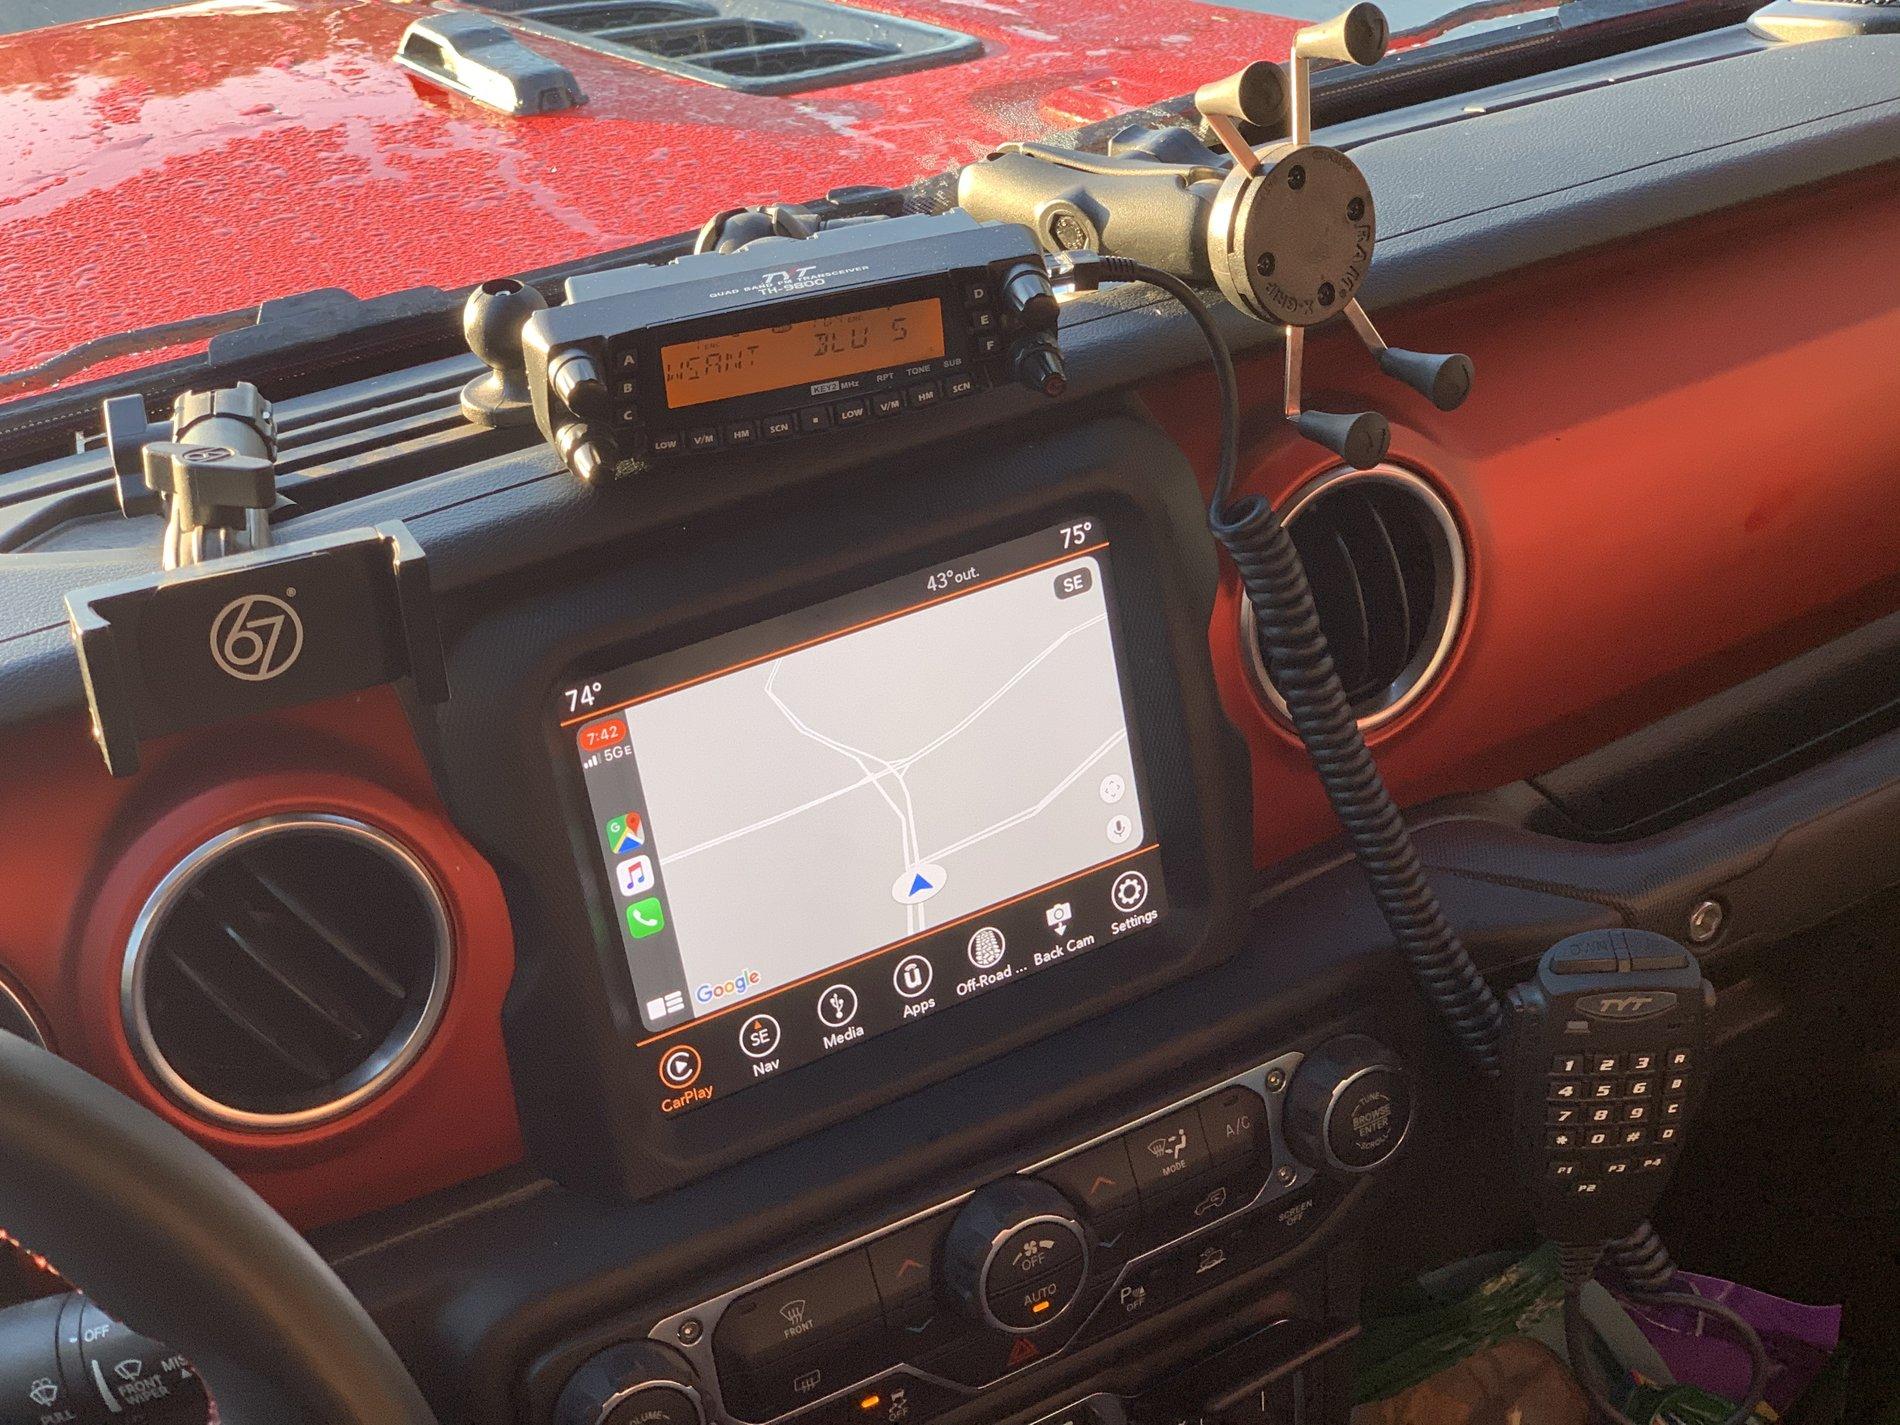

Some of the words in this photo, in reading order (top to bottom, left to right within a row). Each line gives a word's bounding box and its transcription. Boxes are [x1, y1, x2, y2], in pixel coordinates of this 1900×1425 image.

[709, 288, 739, 299] QUAD
[743, 282, 773, 292] BAND
[798, 265, 870, 282] TRANSCEIVER
[758, 278, 826, 297] TH-9800
[974, 289, 984, 299] D
[980, 314, 990, 325] E
[986, 340, 995, 350] F
[623, 355, 635, 366] A
[943, 358, 962, 369] SUB
[876, 372, 895, 383] RPT
[906, 364, 931, 377] TONE
[623, 383, 633, 394] B
[841, 380, 860, 391] MHz
[952, 381, 971, 393] SCN
[918, 391, 934, 402] HM
[841, 408, 864, 420] LOW
[880, 400, 900, 412] V/M
[623, 410, 633, 421] C
[733, 430, 750, 439] HM
[769, 423, 789, 434] SCN
[655, 440, 677, 450] LOW
[694, 434, 714, 445] V/M
[1060, 521, 1092, 549] 75°
[1063, 574, 1084, 593] SE
[222, 597, 286, 679] 67
[565, 682, 601, 712] 74°
[587, 726, 619, 745] 7:42
[1111, 908, 1158, 935] Settings
[1033, 944, 1064, 967] Back
[1066, 934, 1095, 952] Cam
[696, 969, 760, 1003] Google
[956, 964, 1012, 996] Off-Road
[903, 997, 936, 1019] Apps
[1601, 997, 1652, 1012] TYT
[750, 1028, 771, 1047] SE
[823, 1025, 865, 1050] Media
[752, 1058, 780, 1077] Nav
[1564, 1060, 1575, 1072] 1
[1600, 1059, 1615, 1072] 2
[1635, 1057, 1650, 1069] 3
[661, 1084, 713, 1112] CarPlay
[1359, 1091, 1380, 1106] TUNE
[1558, 1086, 1574, 1097] 4
[1596, 1085, 1611, 1097] 5
[1632, 1082, 1647, 1094] 6
[1352, 1103, 1391, 1127] BROWSE
[1558, 1111, 1573, 1122] 7
[1593, 1109, 1608, 1121] 8
[1629, 1107, 1644, 1119] 9
[1668, 1103, 1679, 1113] C
[1225, 1115, 1251, 1139] A/C
[1359, 1117, 1388, 1137] ENTER
[1361, 1134, 1389, 1150] SCROLL
[1161, 1158, 1187, 1177] MODE
[1557, 1166, 1573, 1174] P1
[1608, 1164, 1626, 1173] P3
[1643, 1158, 1662, 1167] P4
[1578, 1184, 1597, 1193] P2
[1021, 1252, 1046, 1272] OFF
[1024, 1283, 1057, 1306] AUTO
[84, 1325, 110, 1343] OFF
[784, 1319, 814, 1339] FRONT
[160, 1354, 189, 1373] MIS
[117, 1374, 163, 1397] FRONT
[888, 1406, 909, 1422] OFF
